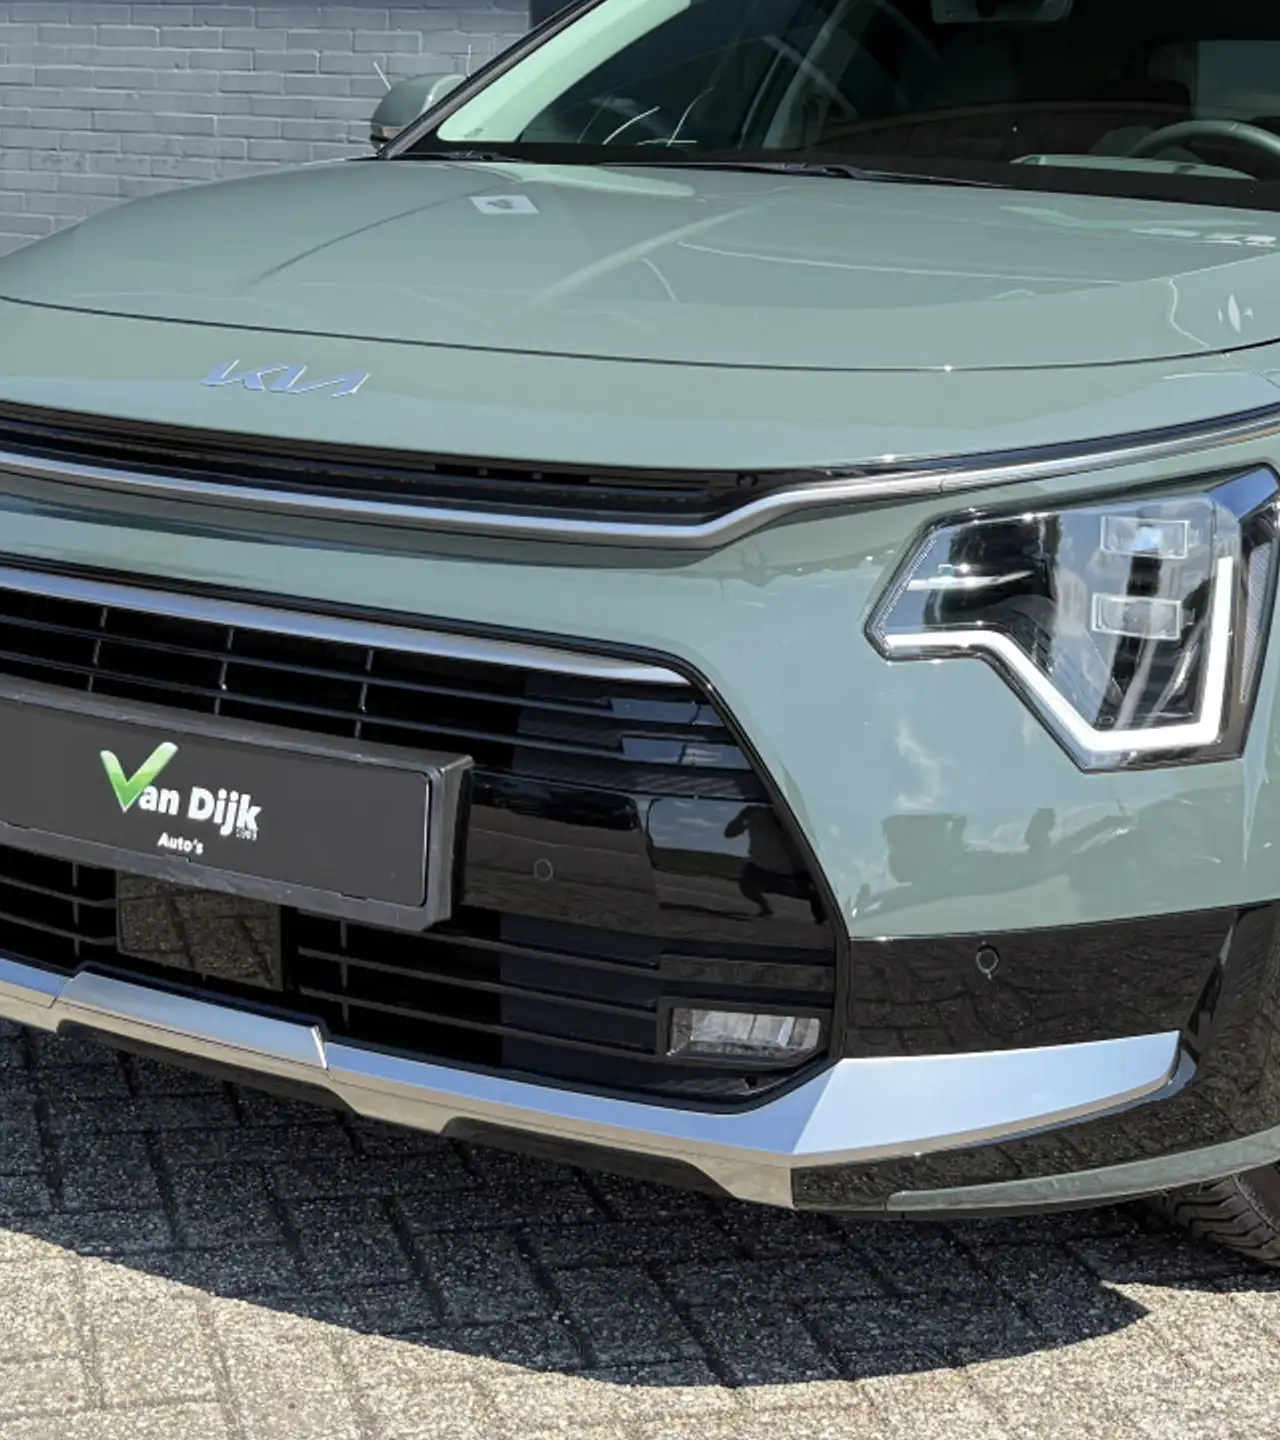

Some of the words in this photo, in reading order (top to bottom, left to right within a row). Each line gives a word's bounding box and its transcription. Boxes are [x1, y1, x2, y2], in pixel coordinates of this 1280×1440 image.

[200, 358, 372, 398] KIA
[187, 786, 262, 837] Dijk
[157, 832, 204, 855] Auto's
